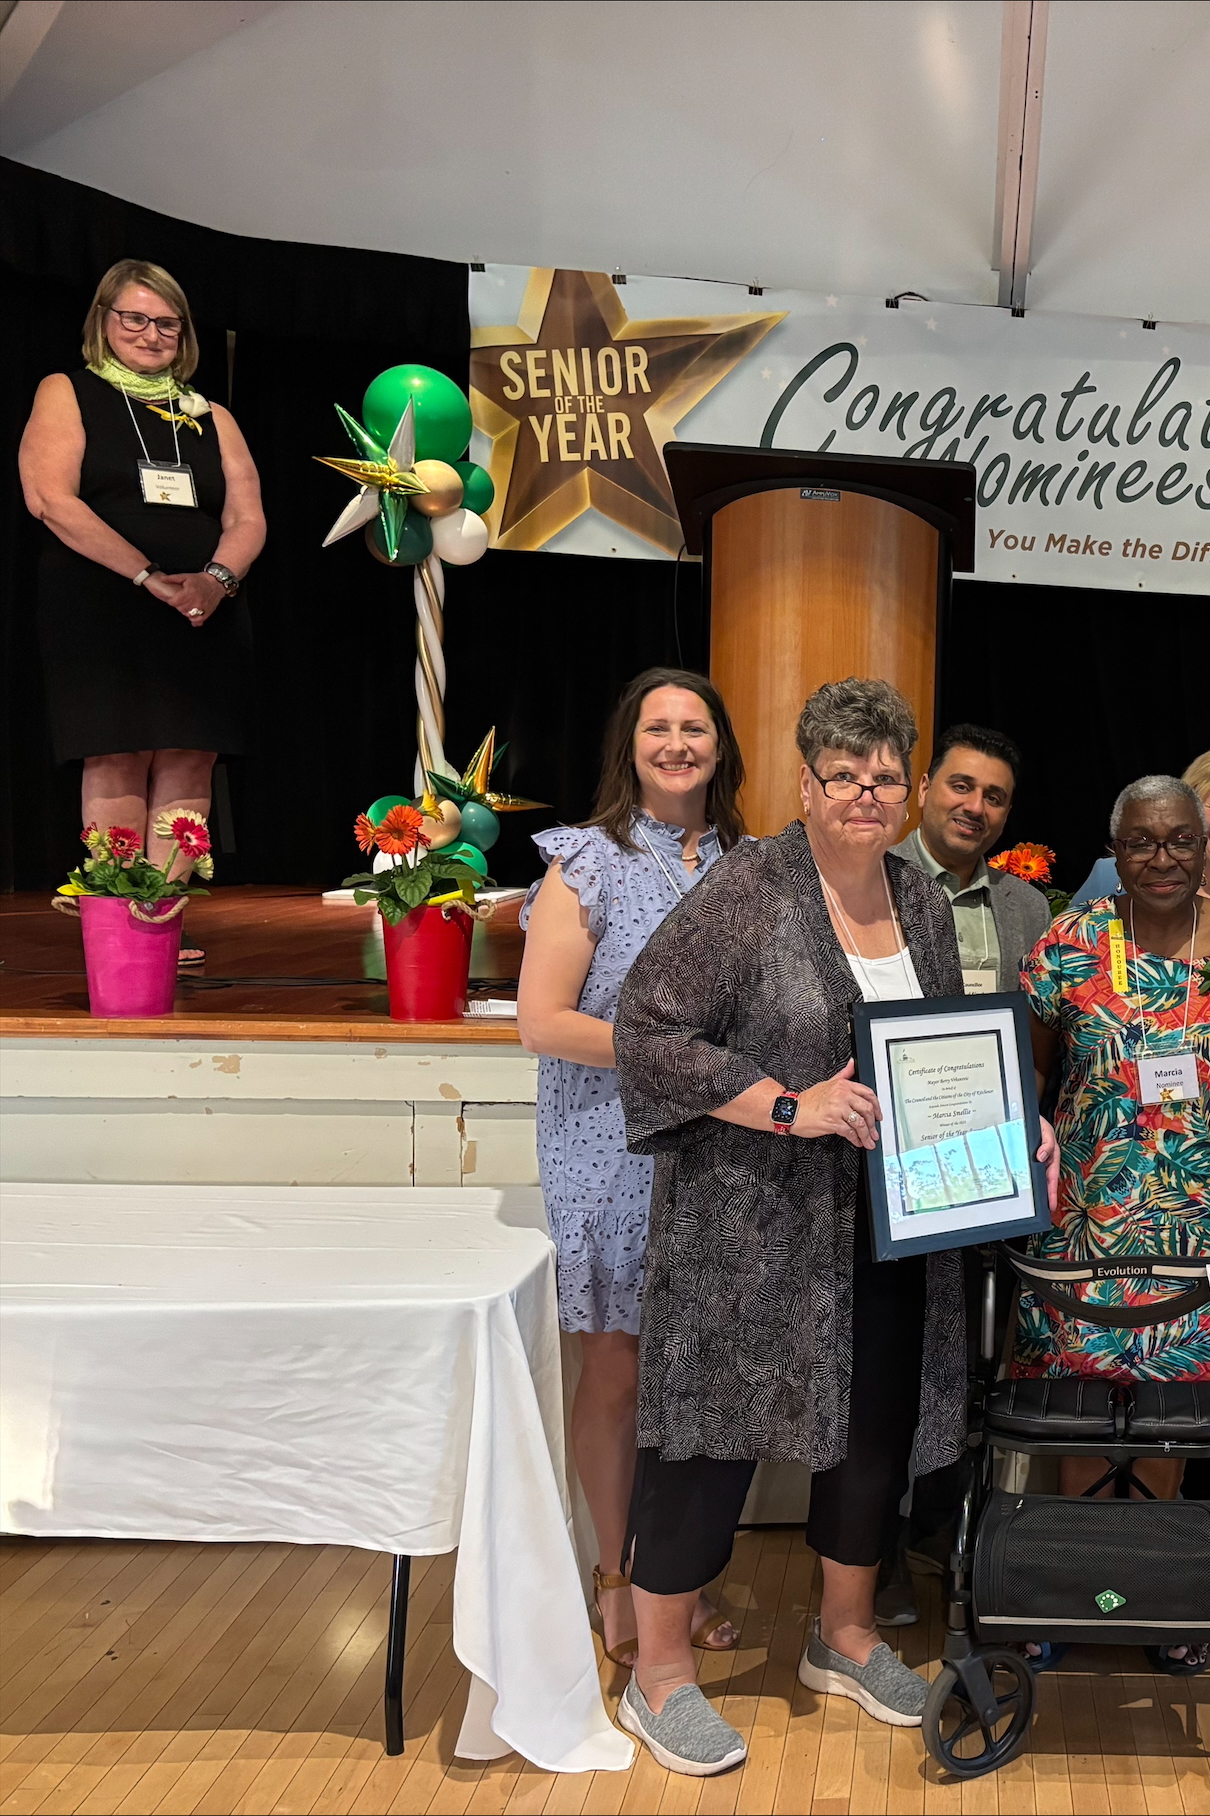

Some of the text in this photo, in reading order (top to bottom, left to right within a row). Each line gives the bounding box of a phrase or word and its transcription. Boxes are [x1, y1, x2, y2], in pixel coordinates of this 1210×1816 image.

[499, 345, 652, 401] SENIOR
[554, 395, 605, 414] OF THE
[527, 411, 635, 463] YEAR
[987, 528, 1036, 551] You
[1044, 532, 1113, 556] Make
[1121, 537, 1164, 560] the
[1115, 943, 1123, 986] HONOUREE
[908, 1062, 984, 1077] Certificate of Congratulations
[1154, 1068, 1183, 1078] Marcia
[1156, 1081, 1184, 1089] Nominee
[1097, 1265, 1148, 1277] Evolution
